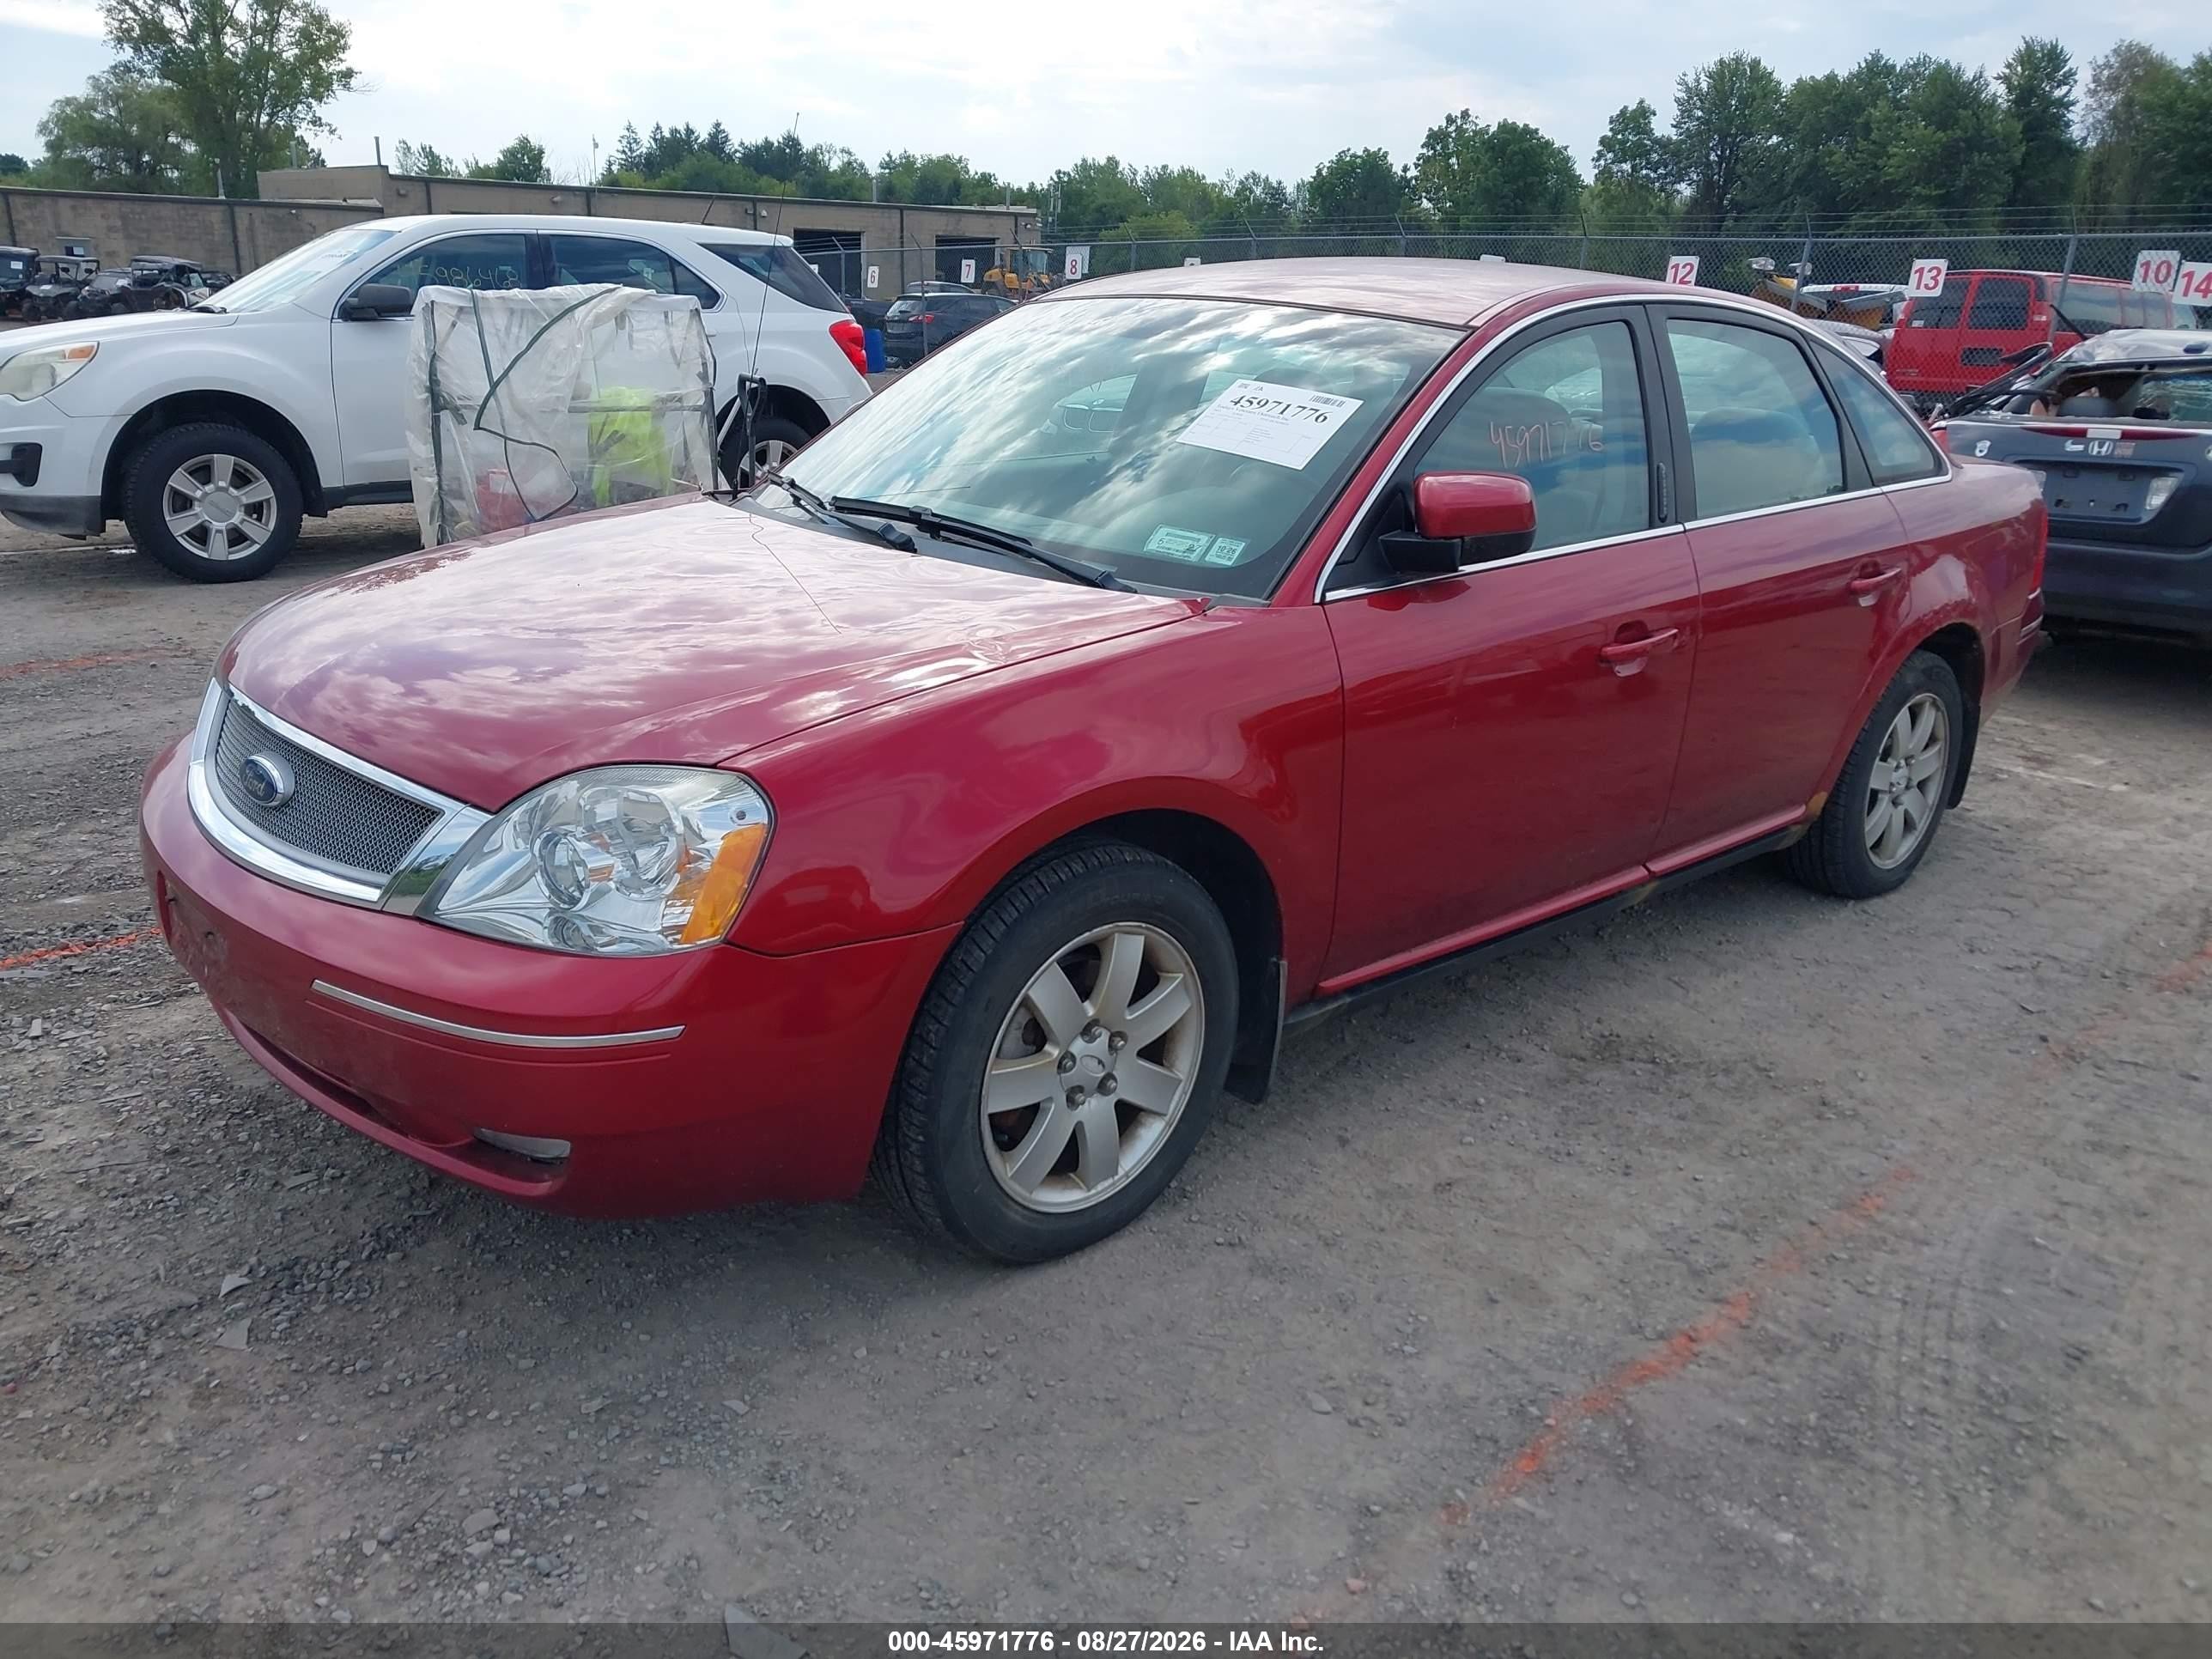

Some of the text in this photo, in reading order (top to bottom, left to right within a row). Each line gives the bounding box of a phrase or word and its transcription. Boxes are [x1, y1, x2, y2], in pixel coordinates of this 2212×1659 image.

[870, 270, 876, 283] 6
[964, 264, 972, 279] 7
[1070, 258, 1079, 276] 8
[1670, 262, 1695, 285] 12
[1913, 265, 1943, 291] 13
[2140, 259, 2172, 284] 10
[2180, 270, 2212, 299] 14
[1229, 394, 1334, 424] 45971776
[242, 763, 267, 798] Ford
